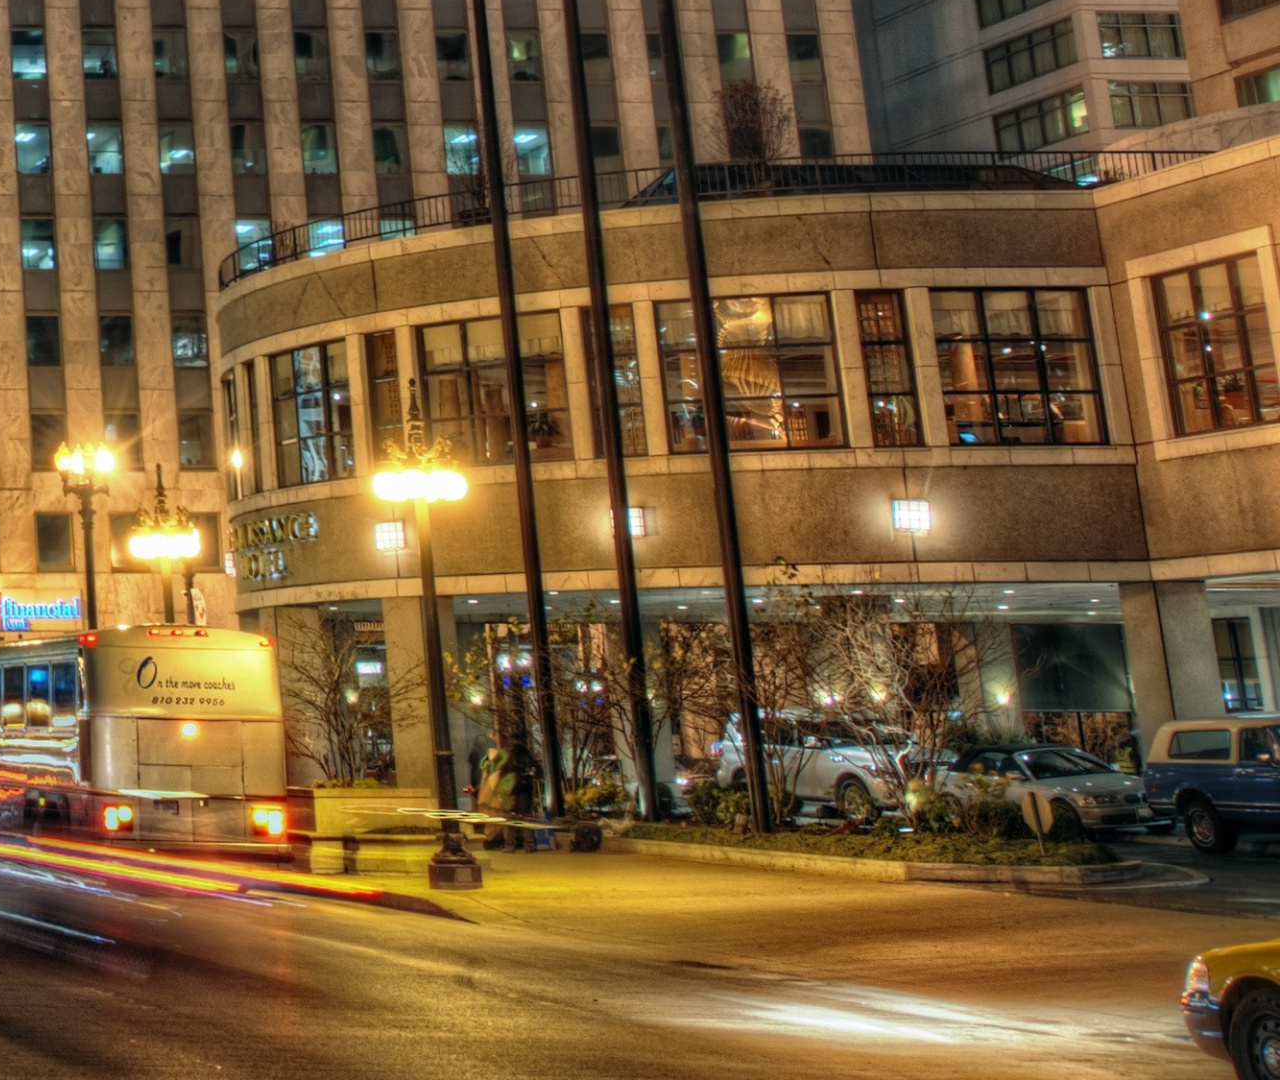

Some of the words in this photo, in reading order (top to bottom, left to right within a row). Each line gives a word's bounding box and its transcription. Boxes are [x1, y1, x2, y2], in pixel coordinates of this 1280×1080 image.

[1, 598, 81, 619] financial
[165, 676, 179, 688] the
[181, 681, 201, 689] move
[204, 677, 236, 690] coaches
